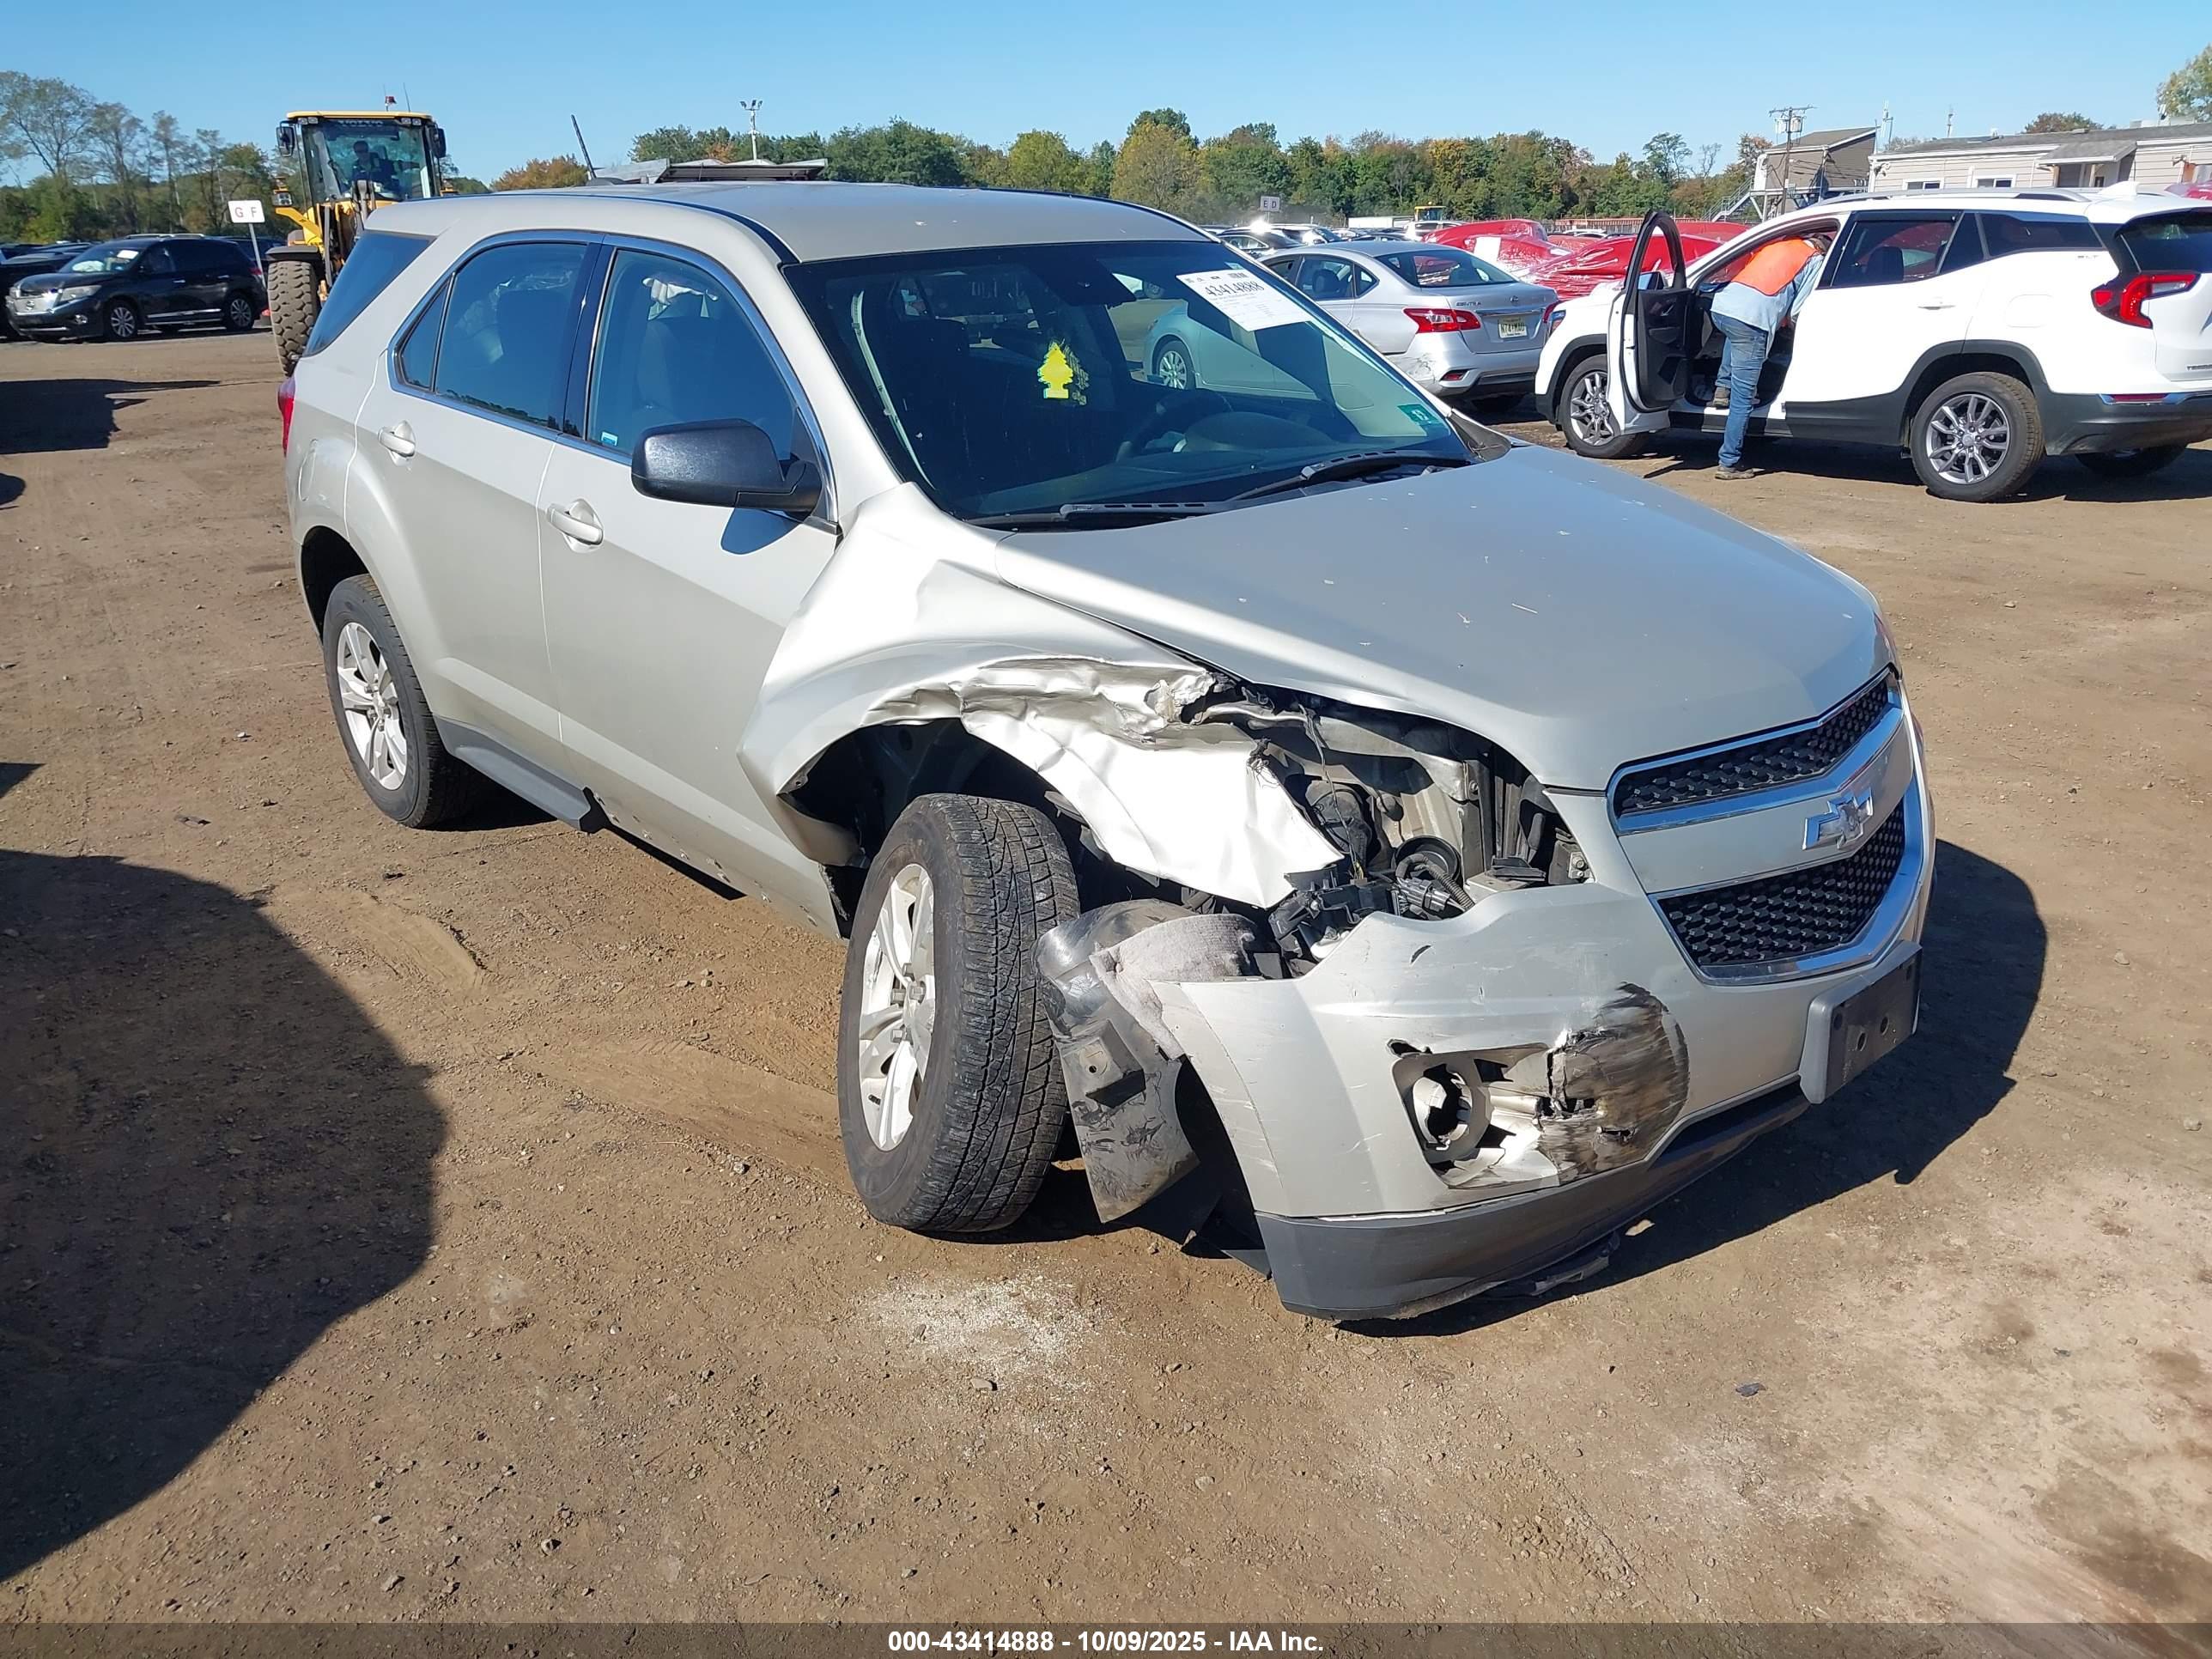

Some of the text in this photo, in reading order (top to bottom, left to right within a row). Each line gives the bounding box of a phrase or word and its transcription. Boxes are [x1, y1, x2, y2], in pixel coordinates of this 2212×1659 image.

[234, 206, 257, 218] G F
[1205, 281, 1264, 296] 43414888
